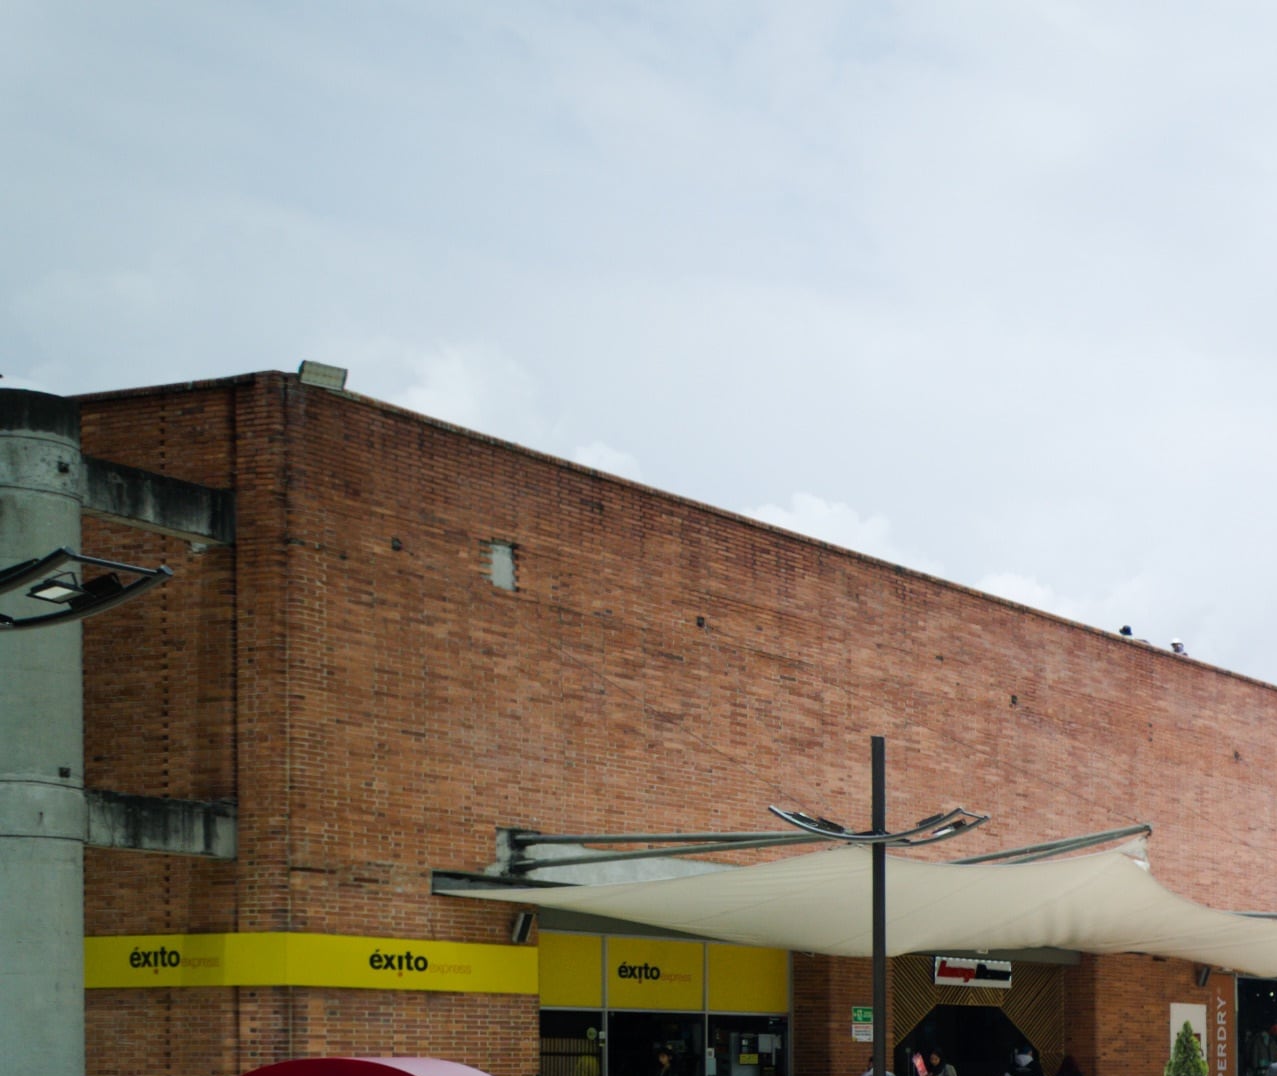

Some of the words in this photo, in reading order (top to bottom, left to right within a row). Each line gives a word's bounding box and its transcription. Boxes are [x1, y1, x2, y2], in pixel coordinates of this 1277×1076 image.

[129, 946, 180, 974] éxito
[369, 949, 428, 977] éxito
[618, 961, 661, 984] éxito
